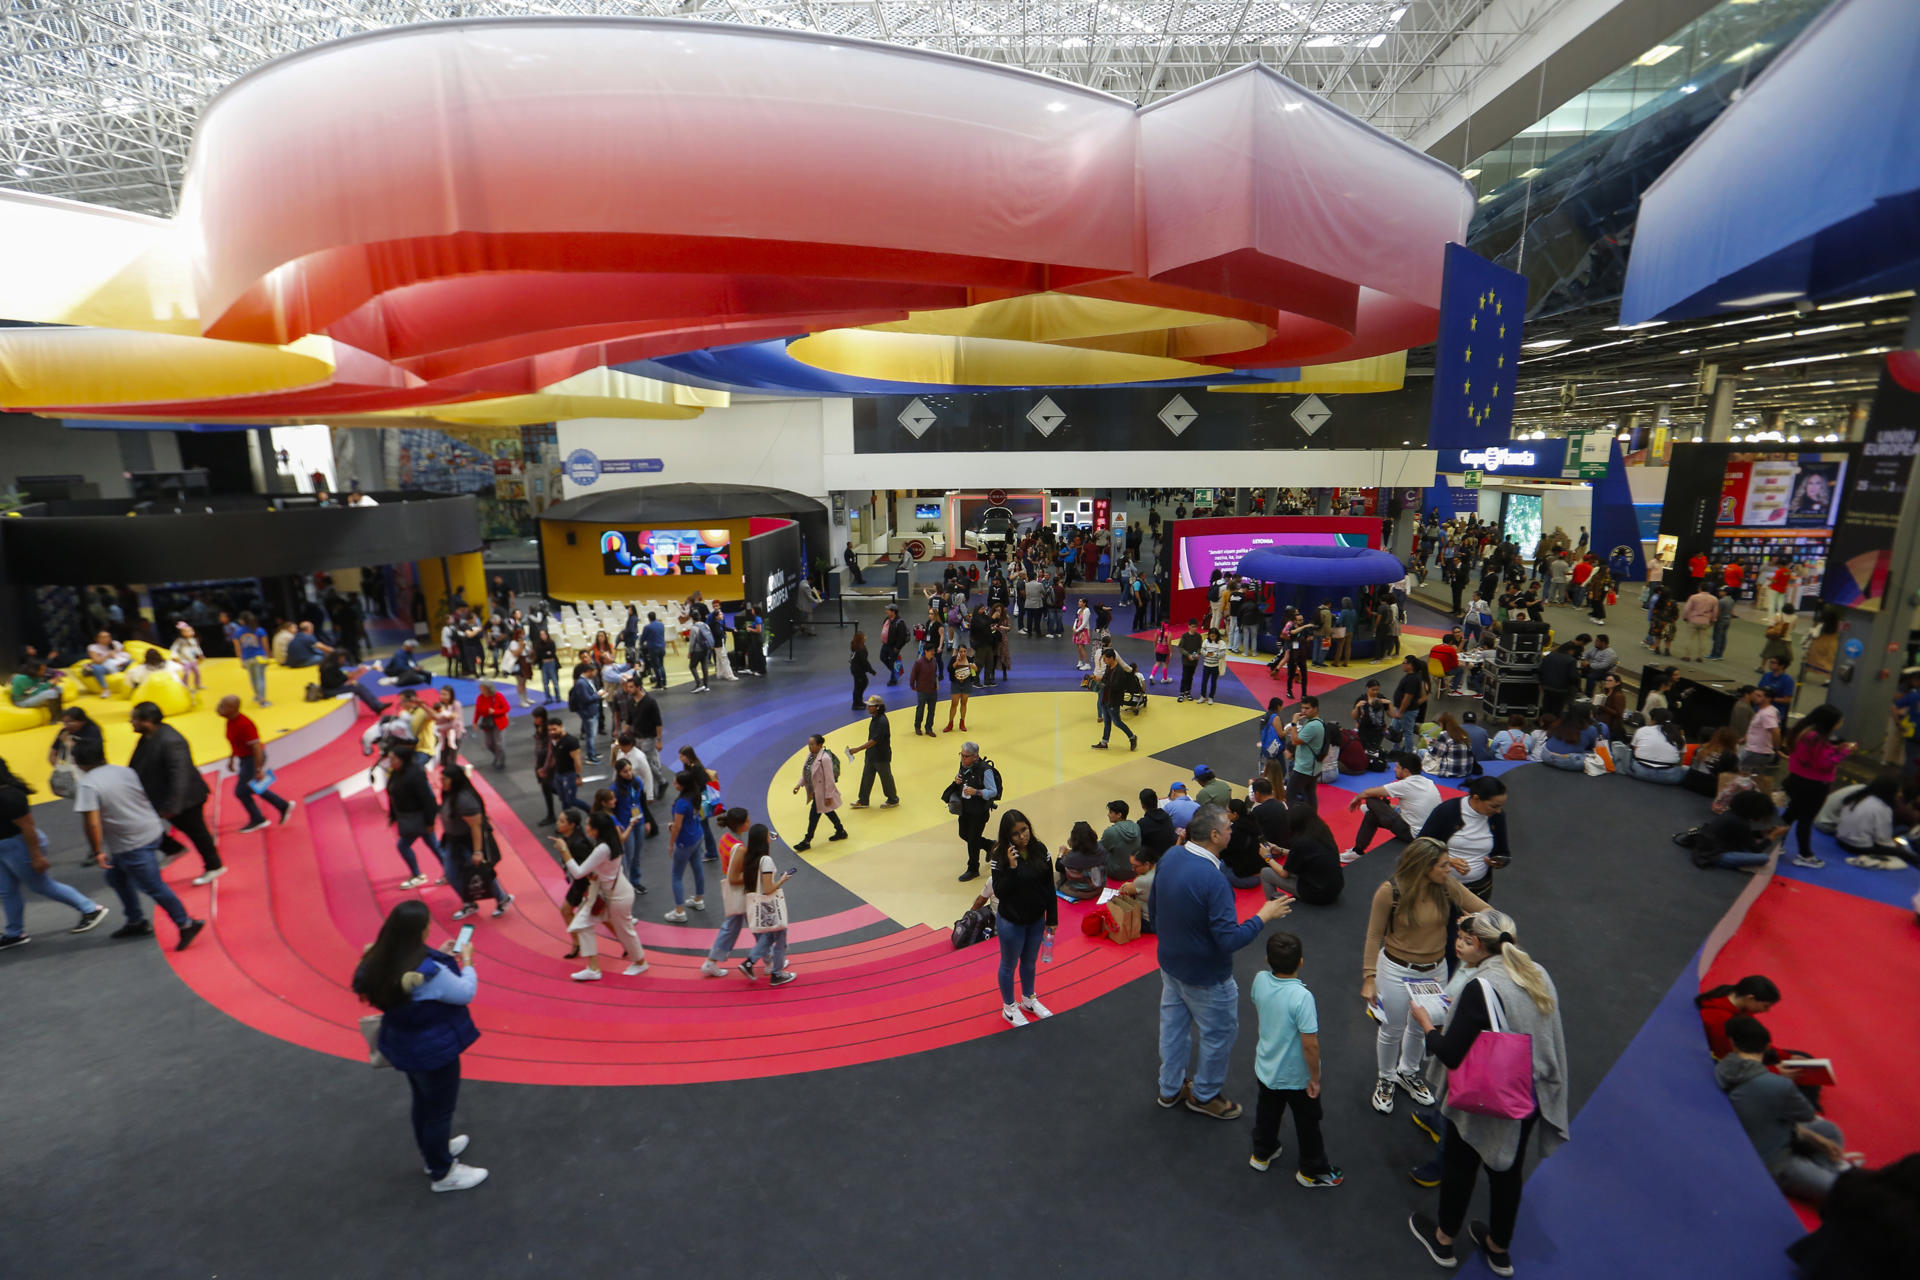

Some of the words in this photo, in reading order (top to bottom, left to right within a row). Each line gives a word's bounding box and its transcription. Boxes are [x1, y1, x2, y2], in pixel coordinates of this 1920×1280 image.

[1877, 428, 1917, 443] UNIÓN
[1566, 434, 1582, 466] F
[1405, 490, 1416, 501] C
